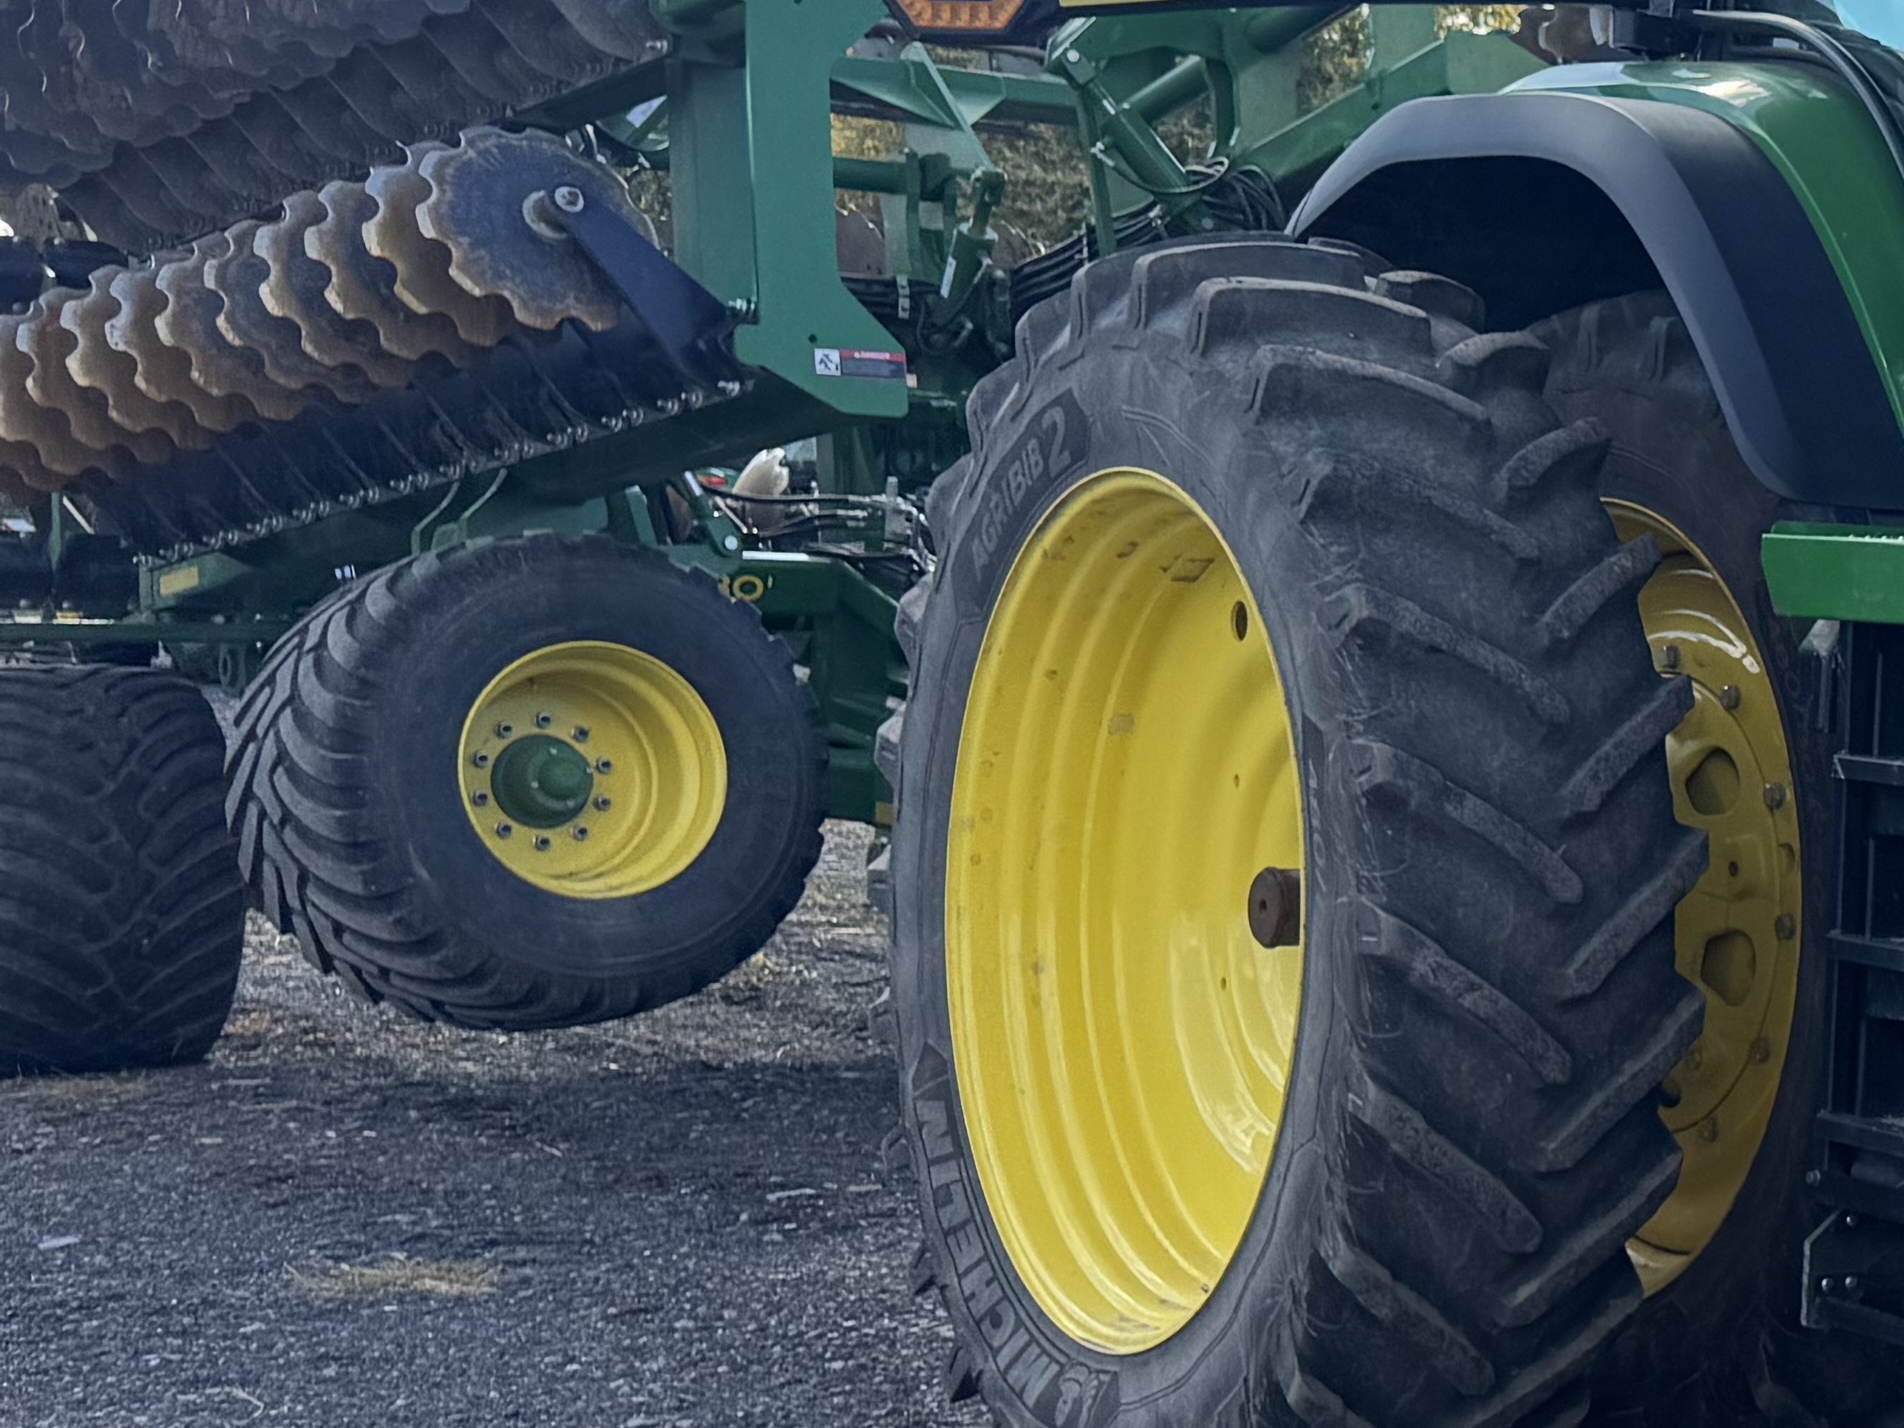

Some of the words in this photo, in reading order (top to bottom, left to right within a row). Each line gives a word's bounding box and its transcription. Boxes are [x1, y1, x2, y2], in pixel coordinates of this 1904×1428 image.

[972, 438, 1044, 582] AGRIBIB
[1042, 406, 1072, 479] 2
[915, 1098, 1066, 1410] MICHELIN
